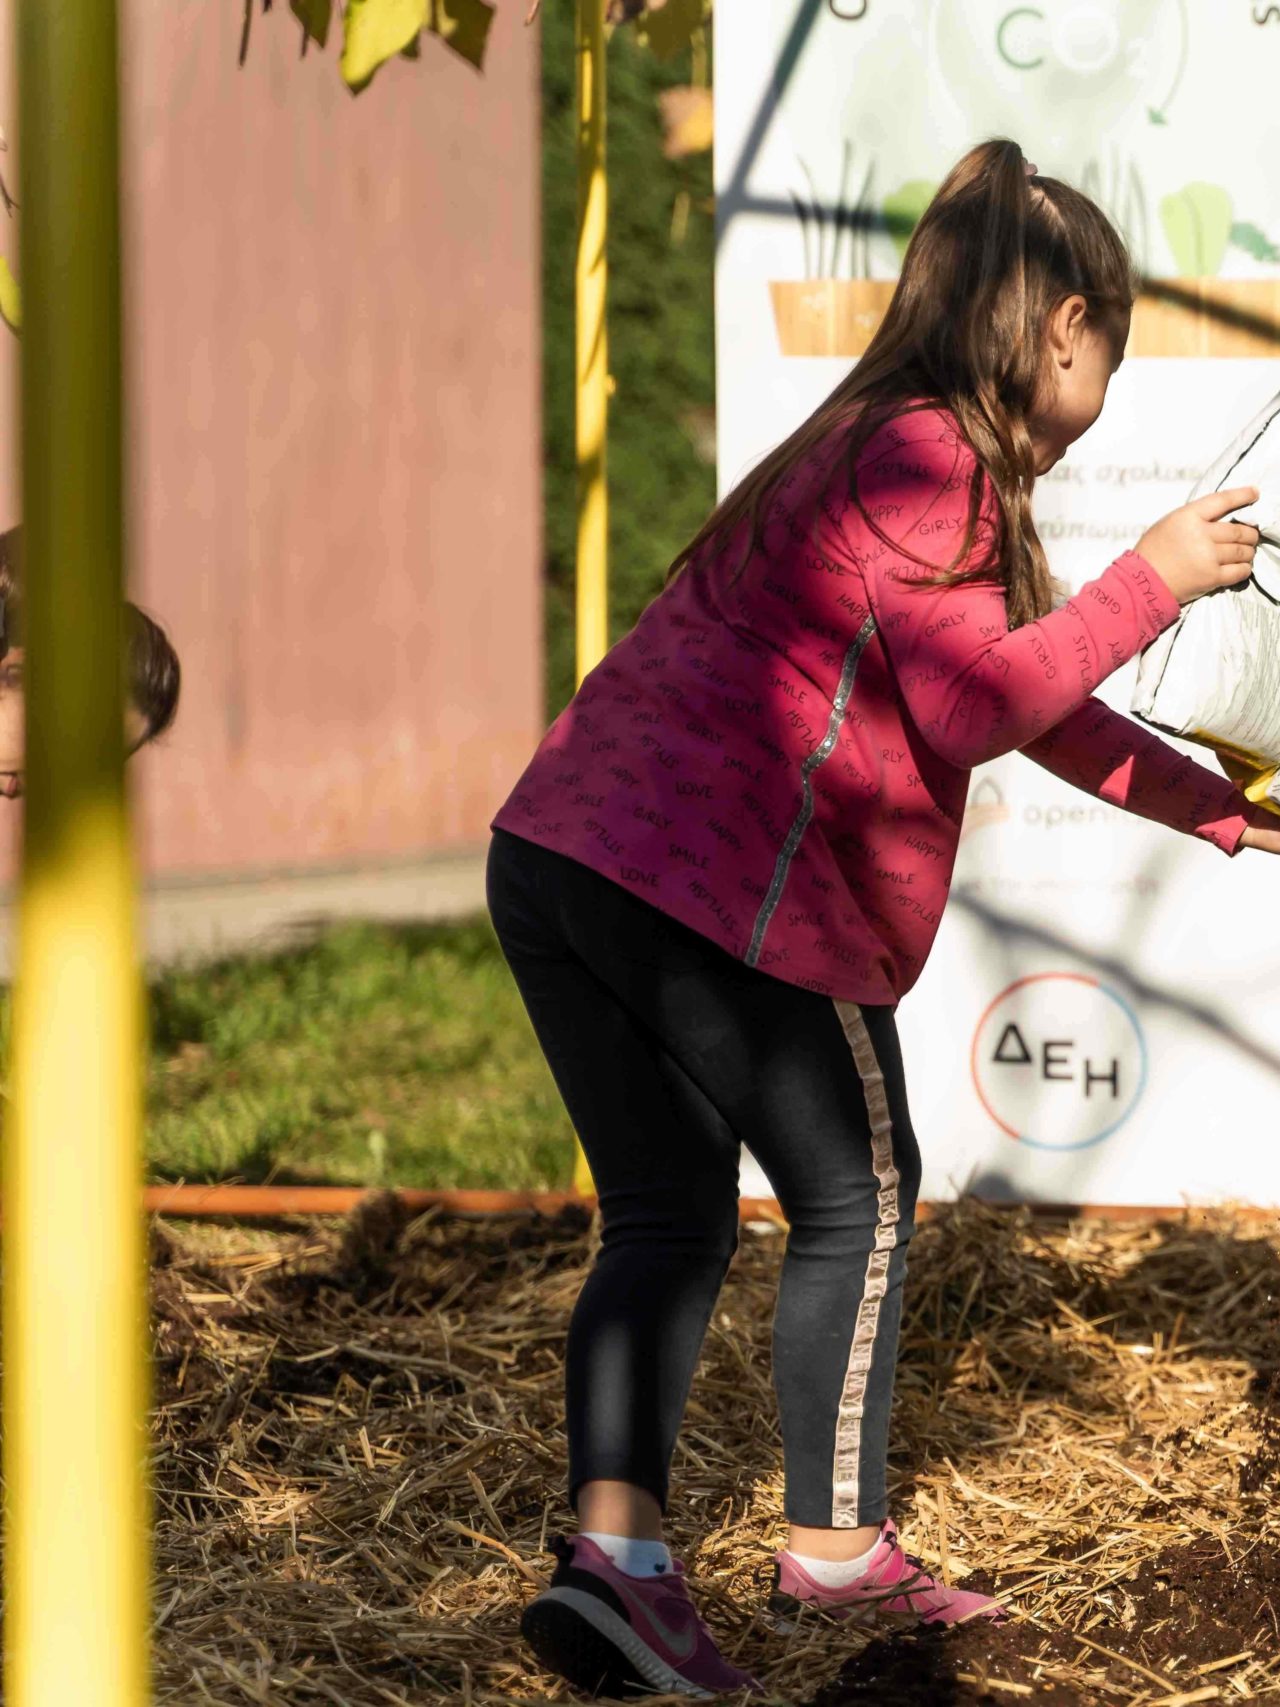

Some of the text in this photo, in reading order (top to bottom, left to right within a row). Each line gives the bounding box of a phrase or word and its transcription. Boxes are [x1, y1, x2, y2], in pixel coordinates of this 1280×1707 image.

[918, 517, 963, 536] GIRLY
[806, 556, 847, 577] LOVE
[762, 579, 803, 606] GIRLY
[1086, 587, 1122, 614] GIRLY
[924, 611, 967, 639] GIRLY
[1027, 636, 1057, 680] GIRLY
[767, 674, 807, 704] SMILE
[722, 755, 765, 783] SMILE
[674, 781, 715, 799] LOVE
[632, 805, 674, 831] GIRLY
[705, 818, 744, 854] HAPPY
[904, 835, 946, 861] HAPPY
[668, 842, 711, 870] SMILE
[619, 866, 660, 888] LOVE
[876, 869, 916, 886] SMILE
[992, 1021, 1119, 1099] ΔΕΗ
